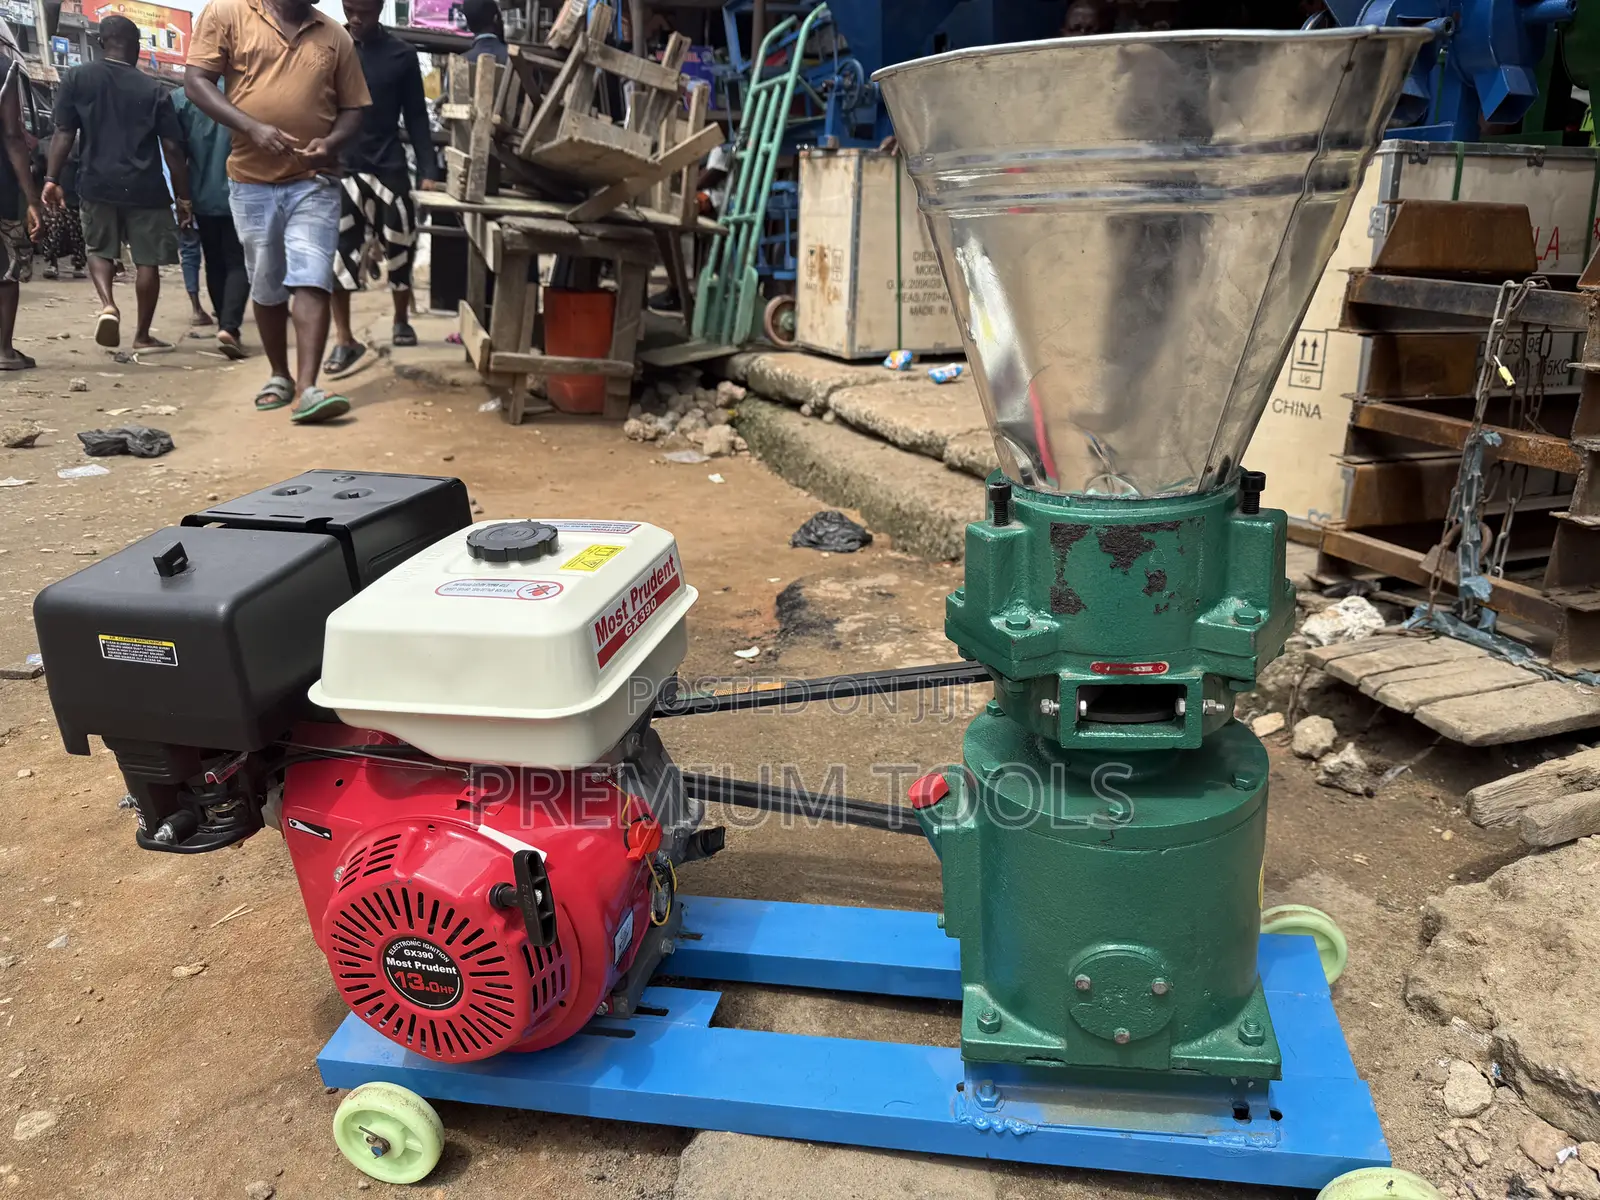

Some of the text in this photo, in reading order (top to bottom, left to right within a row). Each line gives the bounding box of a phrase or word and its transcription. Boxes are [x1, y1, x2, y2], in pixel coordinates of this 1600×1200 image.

[1272, 398, 1322, 420] CHINA
[594, 597, 629, 647] Most
[630, 553, 676, 612] Prudent
[624, 597, 657, 637] GX390
[388, 940, 450, 963] ELECTRONIC IGNITION
[403, 948, 434, 960] GX390
[386, 956, 457, 975] Most Prudent
